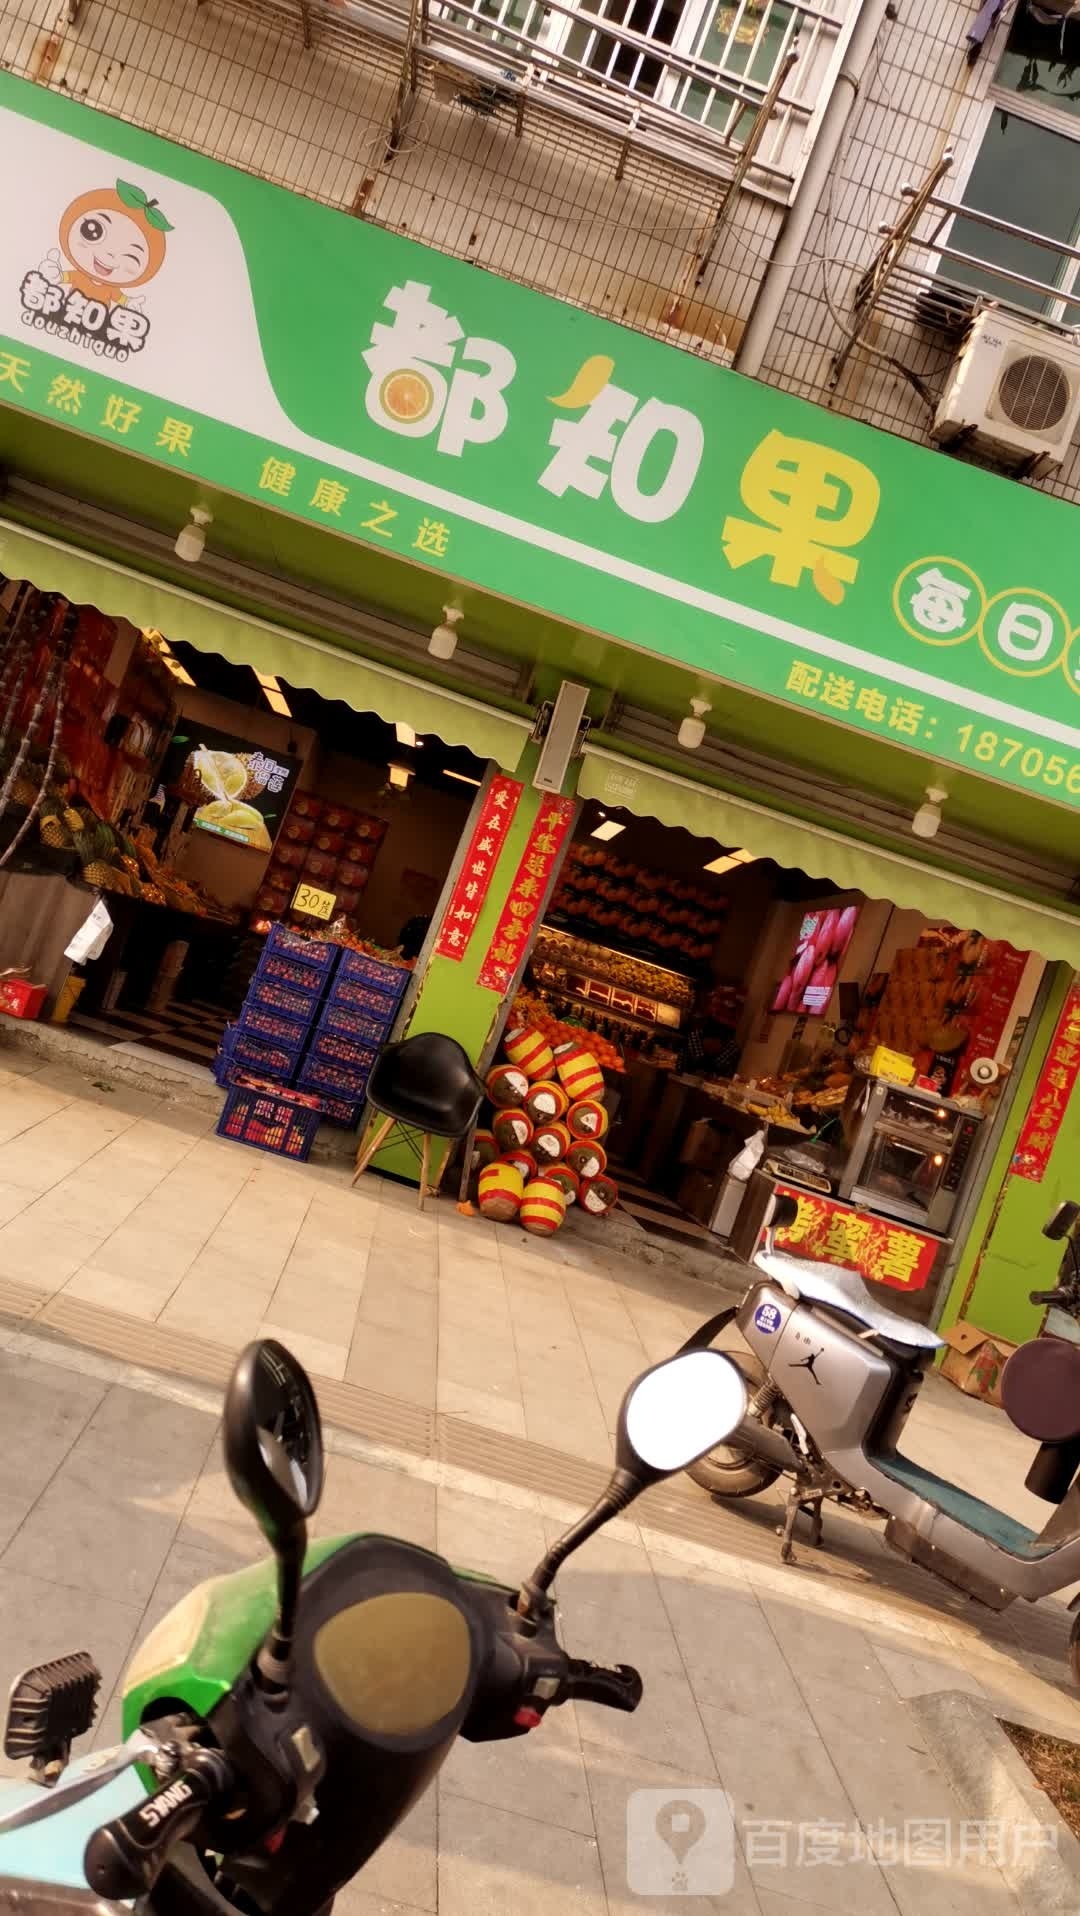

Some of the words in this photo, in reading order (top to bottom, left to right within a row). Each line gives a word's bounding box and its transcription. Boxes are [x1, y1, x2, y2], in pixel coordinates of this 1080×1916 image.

[19, 270, 150, 353] 都知果
[20, 309, 130, 363] douzhiguo
[0, 351, 195, 458] 天然好果
[257, 456, 451, 558] 健康之选
[361, 279, 881, 606] 都知果
[909, 567, 1080, 684] 每日
